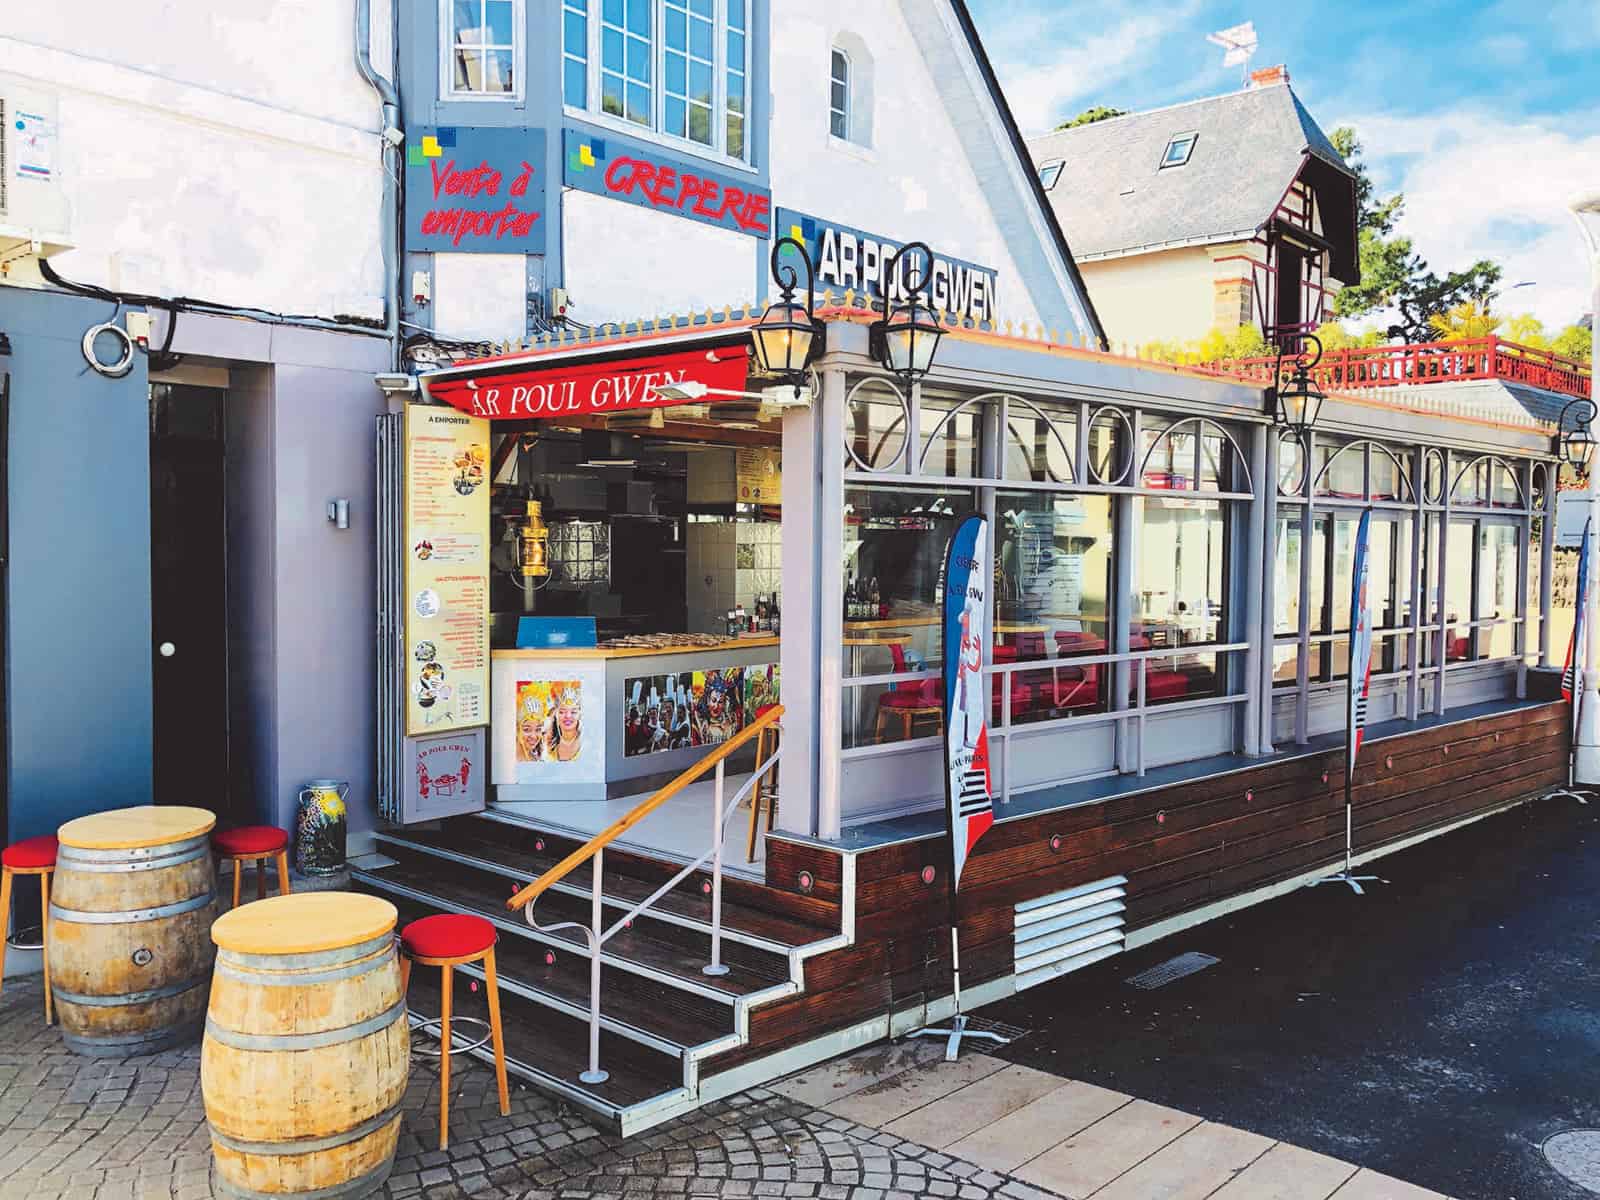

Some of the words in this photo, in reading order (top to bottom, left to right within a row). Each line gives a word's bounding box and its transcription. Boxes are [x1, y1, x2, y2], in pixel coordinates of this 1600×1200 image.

[430, 159, 502, 200] Vente
[510, 161, 534, 197] à
[604, 156, 769, 232] CREPERIE
[420, 201, 541, 246] emporter
[819, 227, 858, 289] AR
[932, 258, 998, 324] GWEN
[472, 386, 500, 416] AR
[510, 378, 583, 414] POUL
